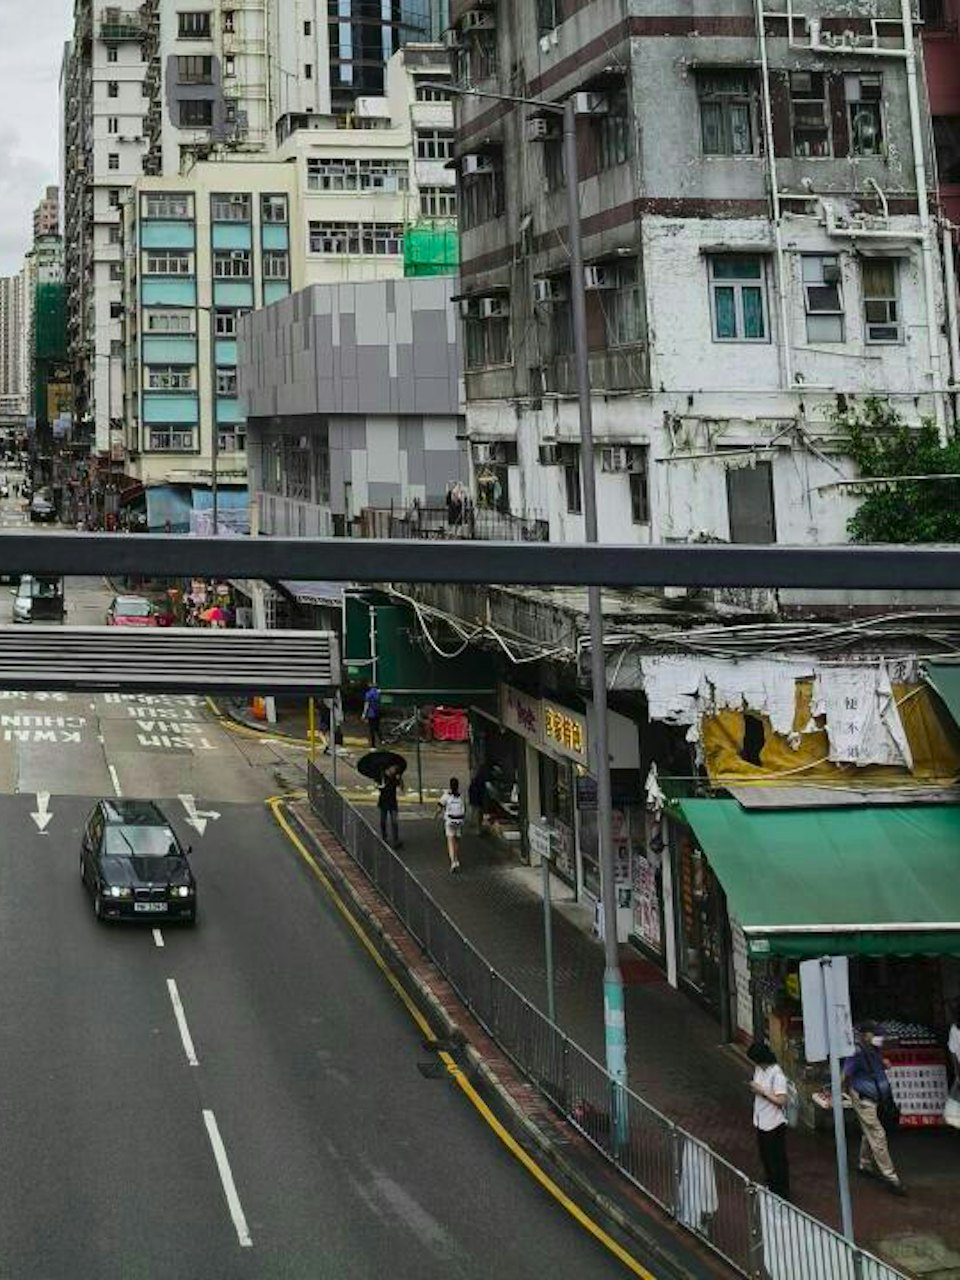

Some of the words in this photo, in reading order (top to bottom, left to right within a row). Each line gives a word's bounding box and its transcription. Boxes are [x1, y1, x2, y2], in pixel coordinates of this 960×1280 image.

[127, 707, 194, 718] TSUI
[136, 720, 202, 733] SHA
[4, 730, 82, 742] KWAI
[137, 734, 219, 749] TSIM
